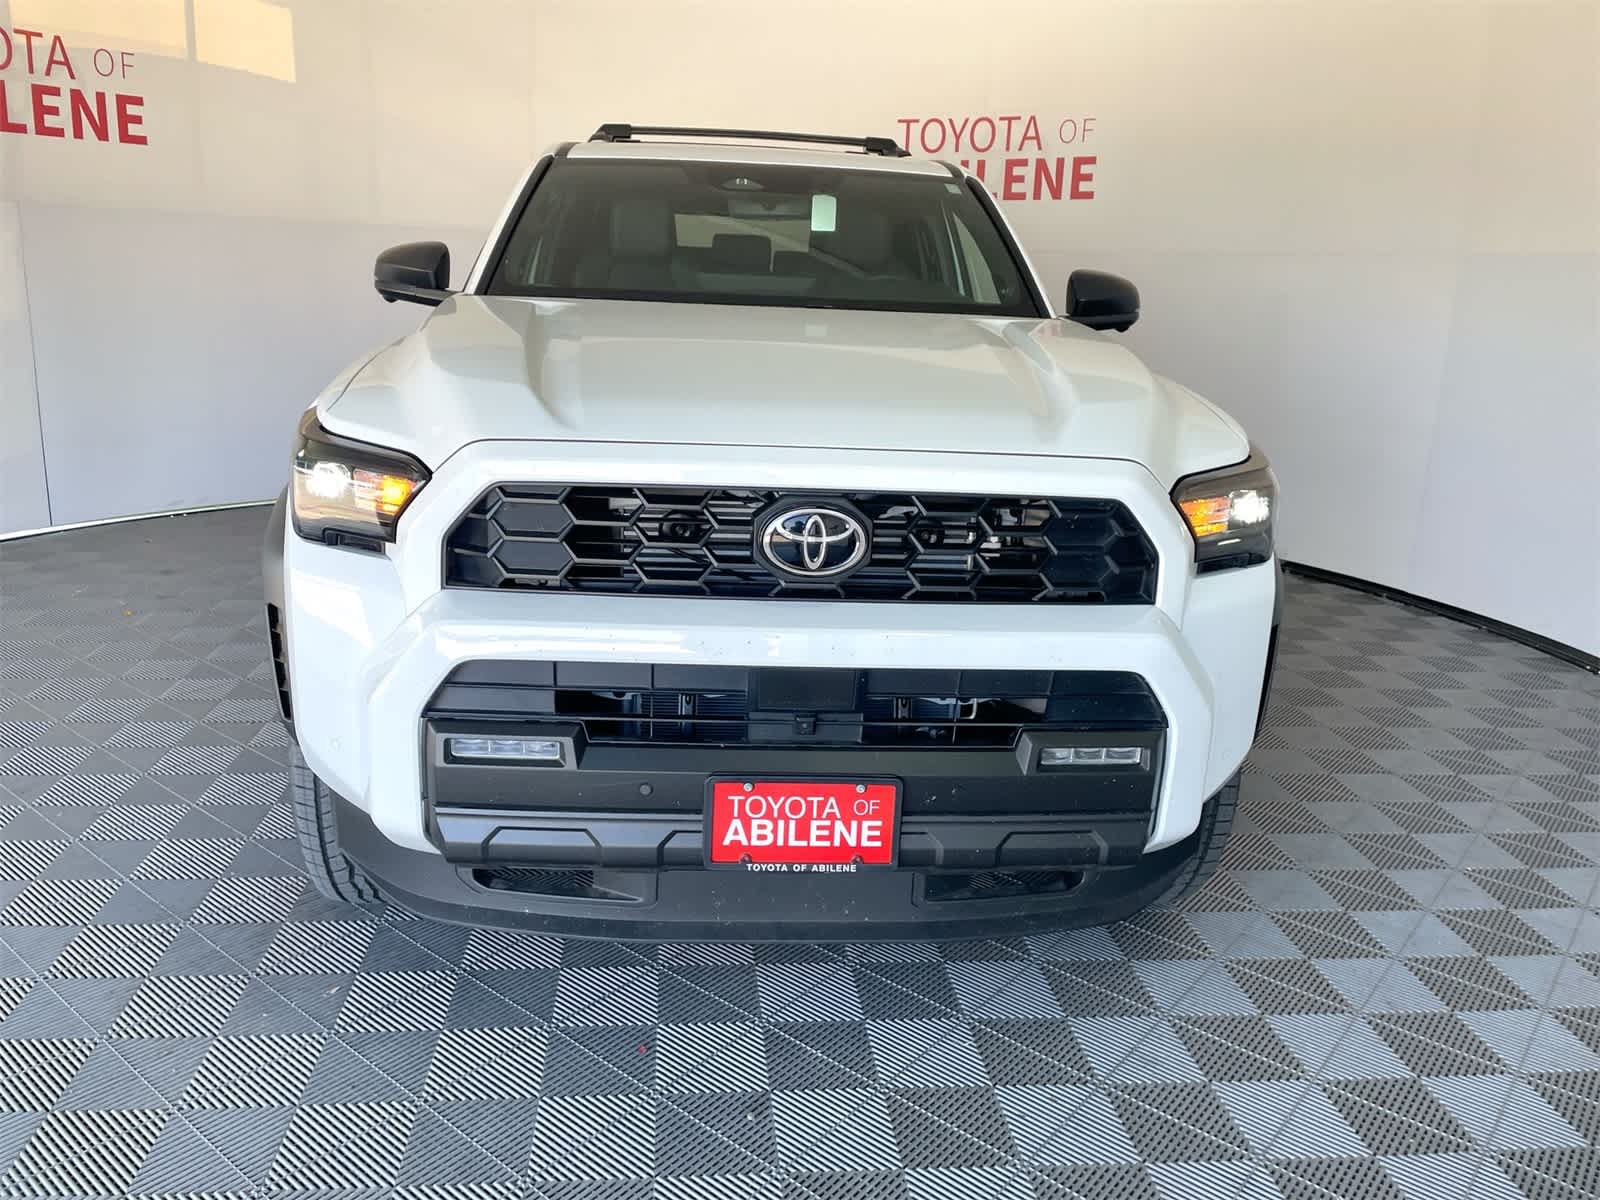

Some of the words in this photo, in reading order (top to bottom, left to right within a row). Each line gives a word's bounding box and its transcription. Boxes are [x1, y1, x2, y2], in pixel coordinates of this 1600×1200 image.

[93, 48, 135, 79] OF
[896, 115, 1043, 154] TOYOTA
[1058, 117, 1097, 145] OF
[727, 795, 841, 819] TOYOTA
[853, 799, 881, 816] OF
[722, 818, 883, 848] ABILENE
[746, 863, 788, 872] TOYOTA
[792, 864, 807, 872] OF
[811, 864, 857, 873] ABILENE
